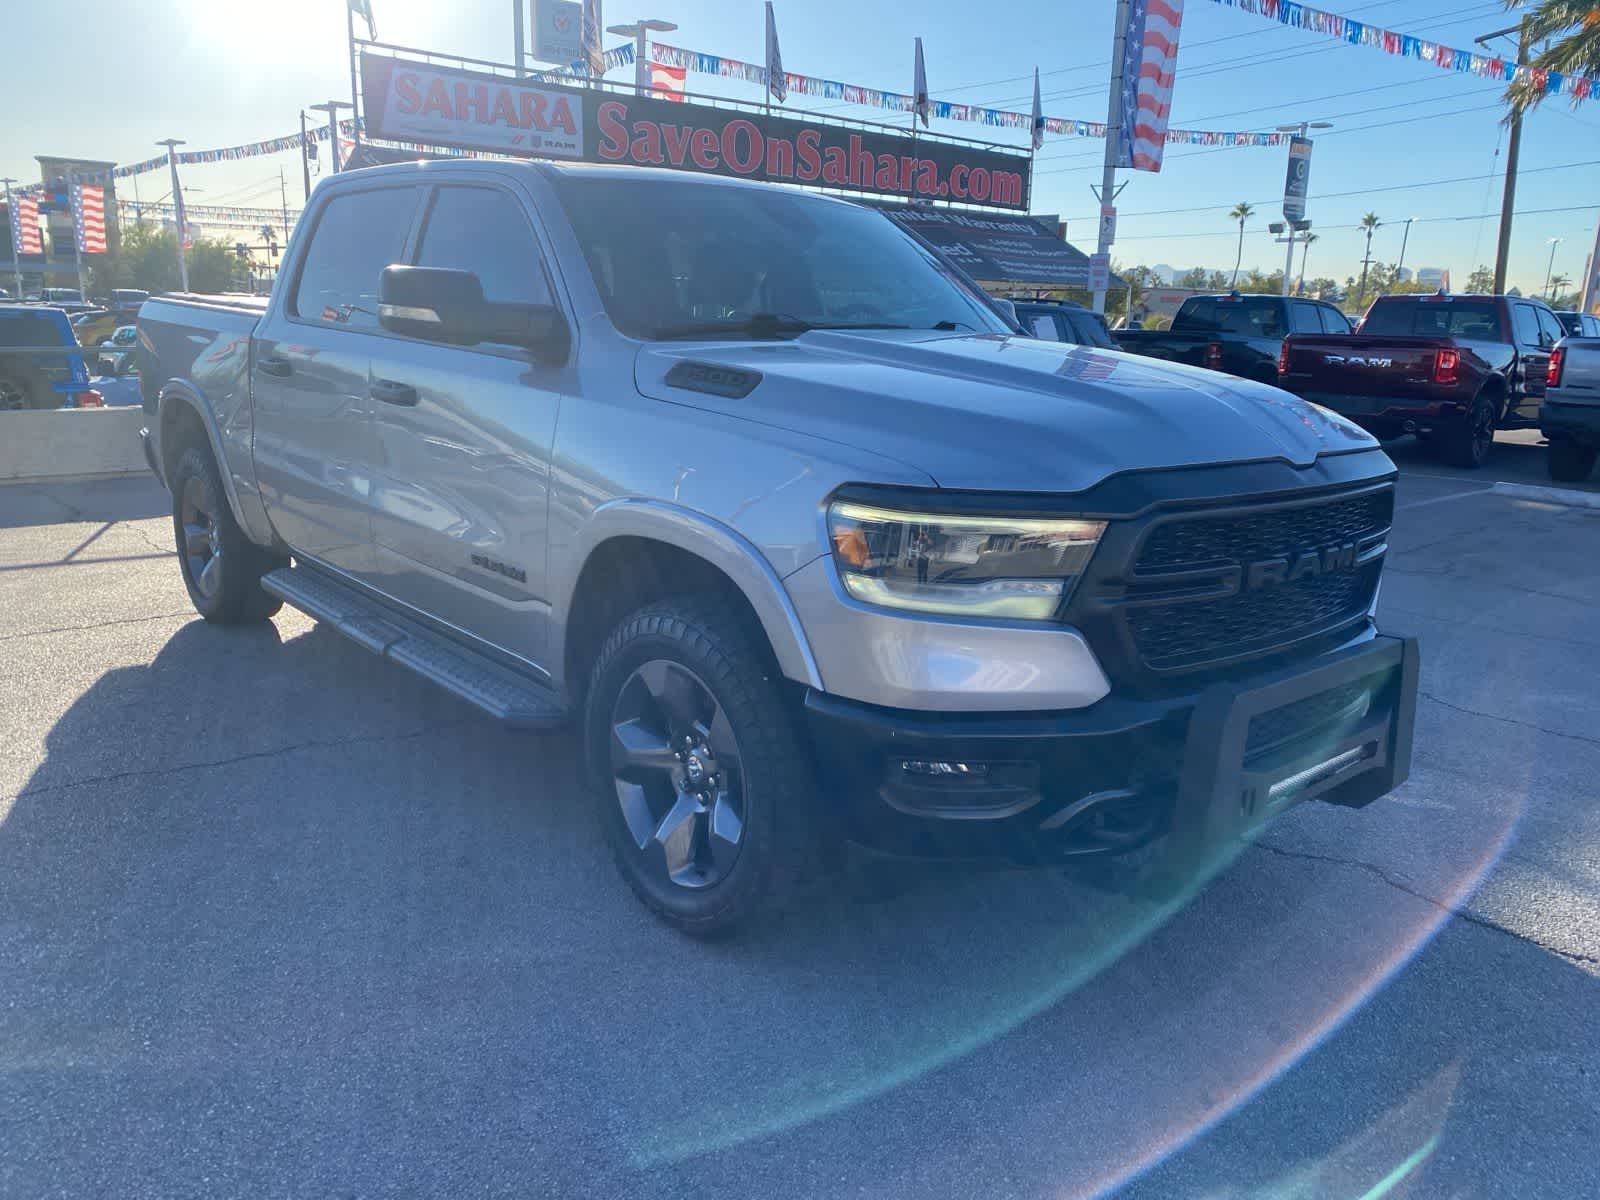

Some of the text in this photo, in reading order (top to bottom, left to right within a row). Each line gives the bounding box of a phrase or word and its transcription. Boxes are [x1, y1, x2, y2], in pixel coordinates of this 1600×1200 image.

[394, 72, 577, 136] SAHARA
[597, 101, 1022, 206] SaveOnSahara.com
[946, 213, 1038, 236] Warranty
[1325, 355, 1392, 368] RAM
[1246, 543, 1356, 590] RAM
